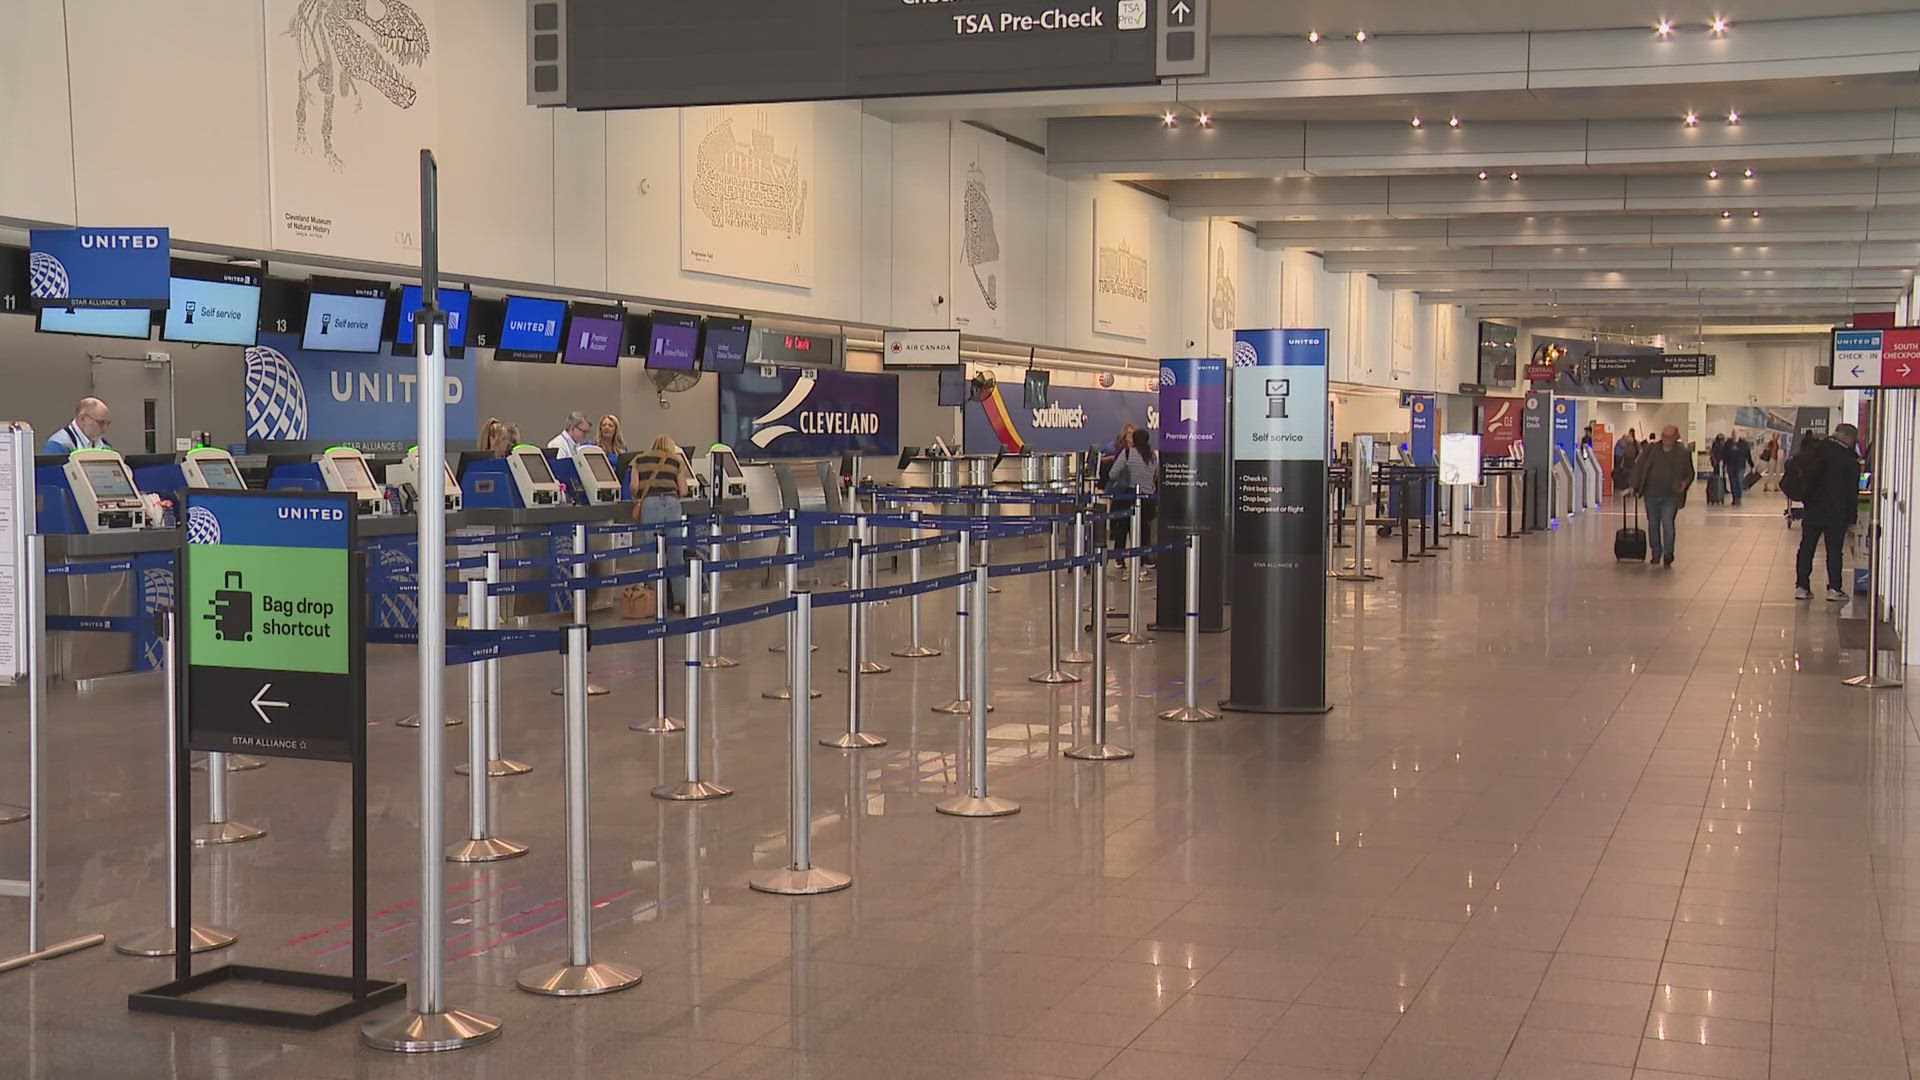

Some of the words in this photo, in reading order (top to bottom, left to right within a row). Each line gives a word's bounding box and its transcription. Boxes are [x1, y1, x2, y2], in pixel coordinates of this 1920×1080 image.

[954, 14, 994, 34] TSA
[1000, 6, 1103, 32] Pre-Check
[285, 212, 310, 223] Cleveland
[311, 215, 332, 225] Museum
[287, 221, 293, 230] of
[293, 222, 312, 231] Natural
[312, 225, 331, 235] History
[81, 235, 160, 249] UNITED
[223, 274, 245, 284] UNITED
[3, 294, 17, 311] 11
[71, 299, 88, 307] STAR
[88, 299, 119, 307] ALLIANCE
[200, 306, 216, 318] Self
[215, 308, 242, 321] service
[276, 318, 288, 333] 13
[334, 317, 347, 329] Self
[346, 319, 369, 331] service
[509, 320, 545, 333] UNITED
[477, 334, 486, 346] 15
[1288, 338, 1320, 346] UNITED
[1893, 343, 1919, 351] SOUTH
[1838, 352, 1863, 360] CHECK
[1869, 352, 1878, 360] IN
[764, 367, 772, 376] 19
[805, 370, 814, 379] 20
[330, 370, 463, 404] UNITD
[1032, 400, 1083, 429] Southwest
[799, 411, 879, 434] CLEVELAND
[1165, 432, 1188, 440] Premier
[1252, 432, 1269, 442] Self
[1269, 433, 1304, 443] service
[342, 441, 360, 451] STAR
[362, 442, 397, 452] ALLIANCE
[1242, 475, 1262, 483] Check
[1261, 475, 1268, 483] in
[1242, 485, 1256, 493] Print
[1256, 485, 1268, 494] bag
[1268, 486, 1283, 494] tags
[1242, 495, 1256, 504] Drop
[1256, 495, 1272, 504] bags
[278, 507, 344, 521] UNITED
[1242, 505, 1265, 514] Change
[1287, 505, 1304, 514] flight
[262, 595, 294, 617] Bag
[296, 597, 334, 618] drop
[262, 618, 331, 638] shortcut
[232, 736, 254, 747] STAR
[255, 737, 297, 750] ALLIANCE
